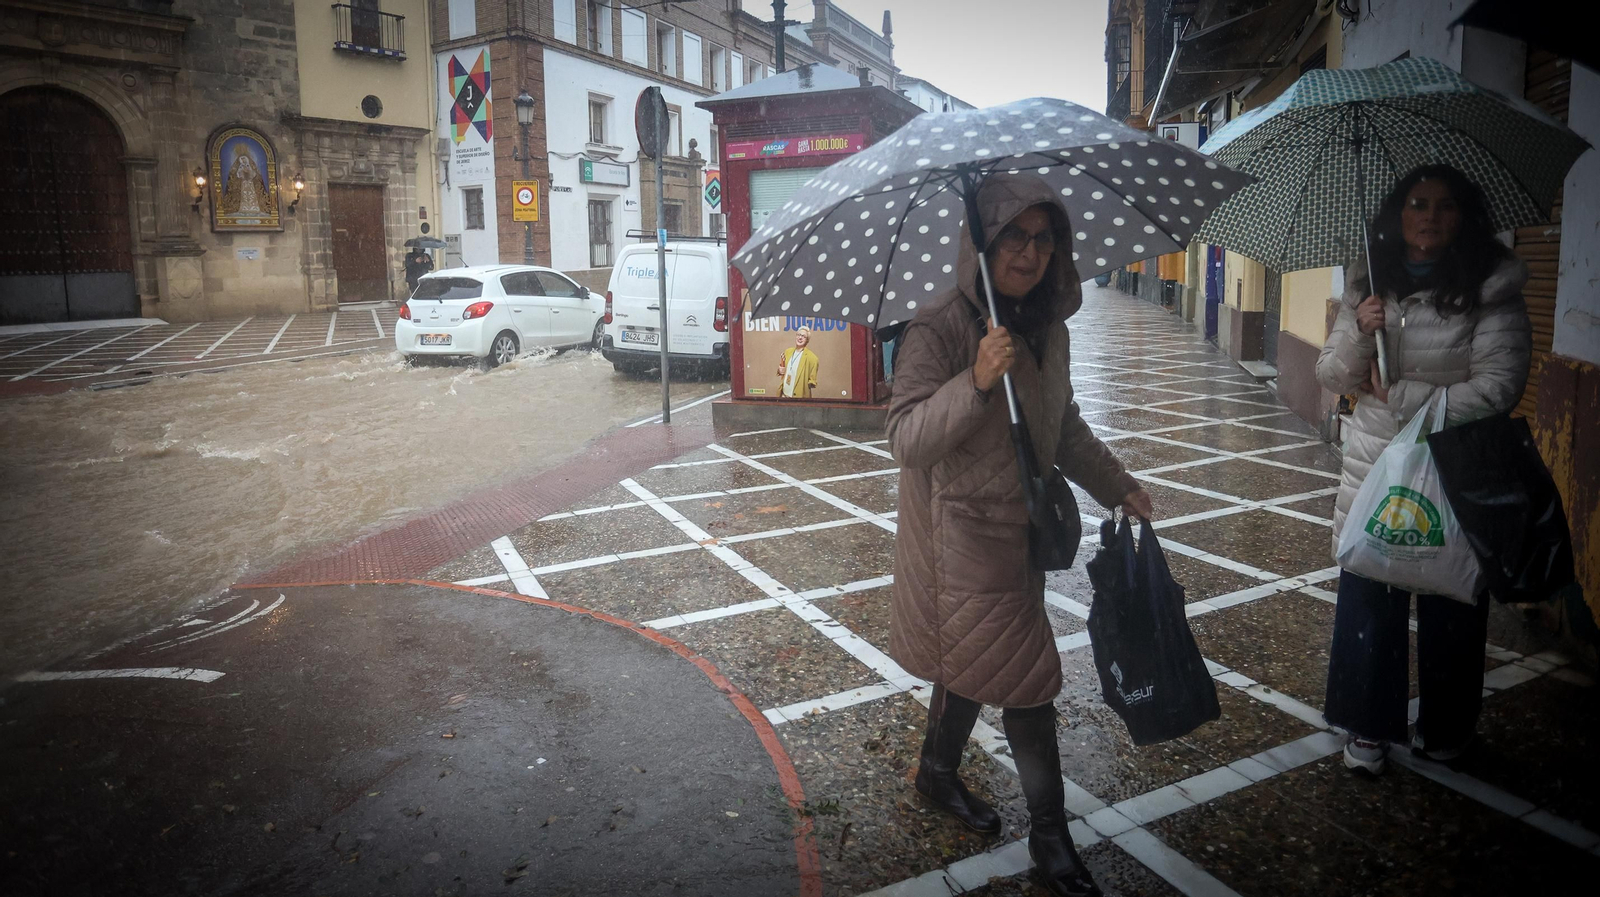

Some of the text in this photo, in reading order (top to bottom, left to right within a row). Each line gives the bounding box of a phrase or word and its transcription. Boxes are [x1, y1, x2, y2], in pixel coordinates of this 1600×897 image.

[810, 138, 848, 151] 1.000.000€
[627, 266, 654, 278] Triple
[745, 312, 847, 332] BIEN JUGADO
[625, 332, 655, 342] 8424 JHS
